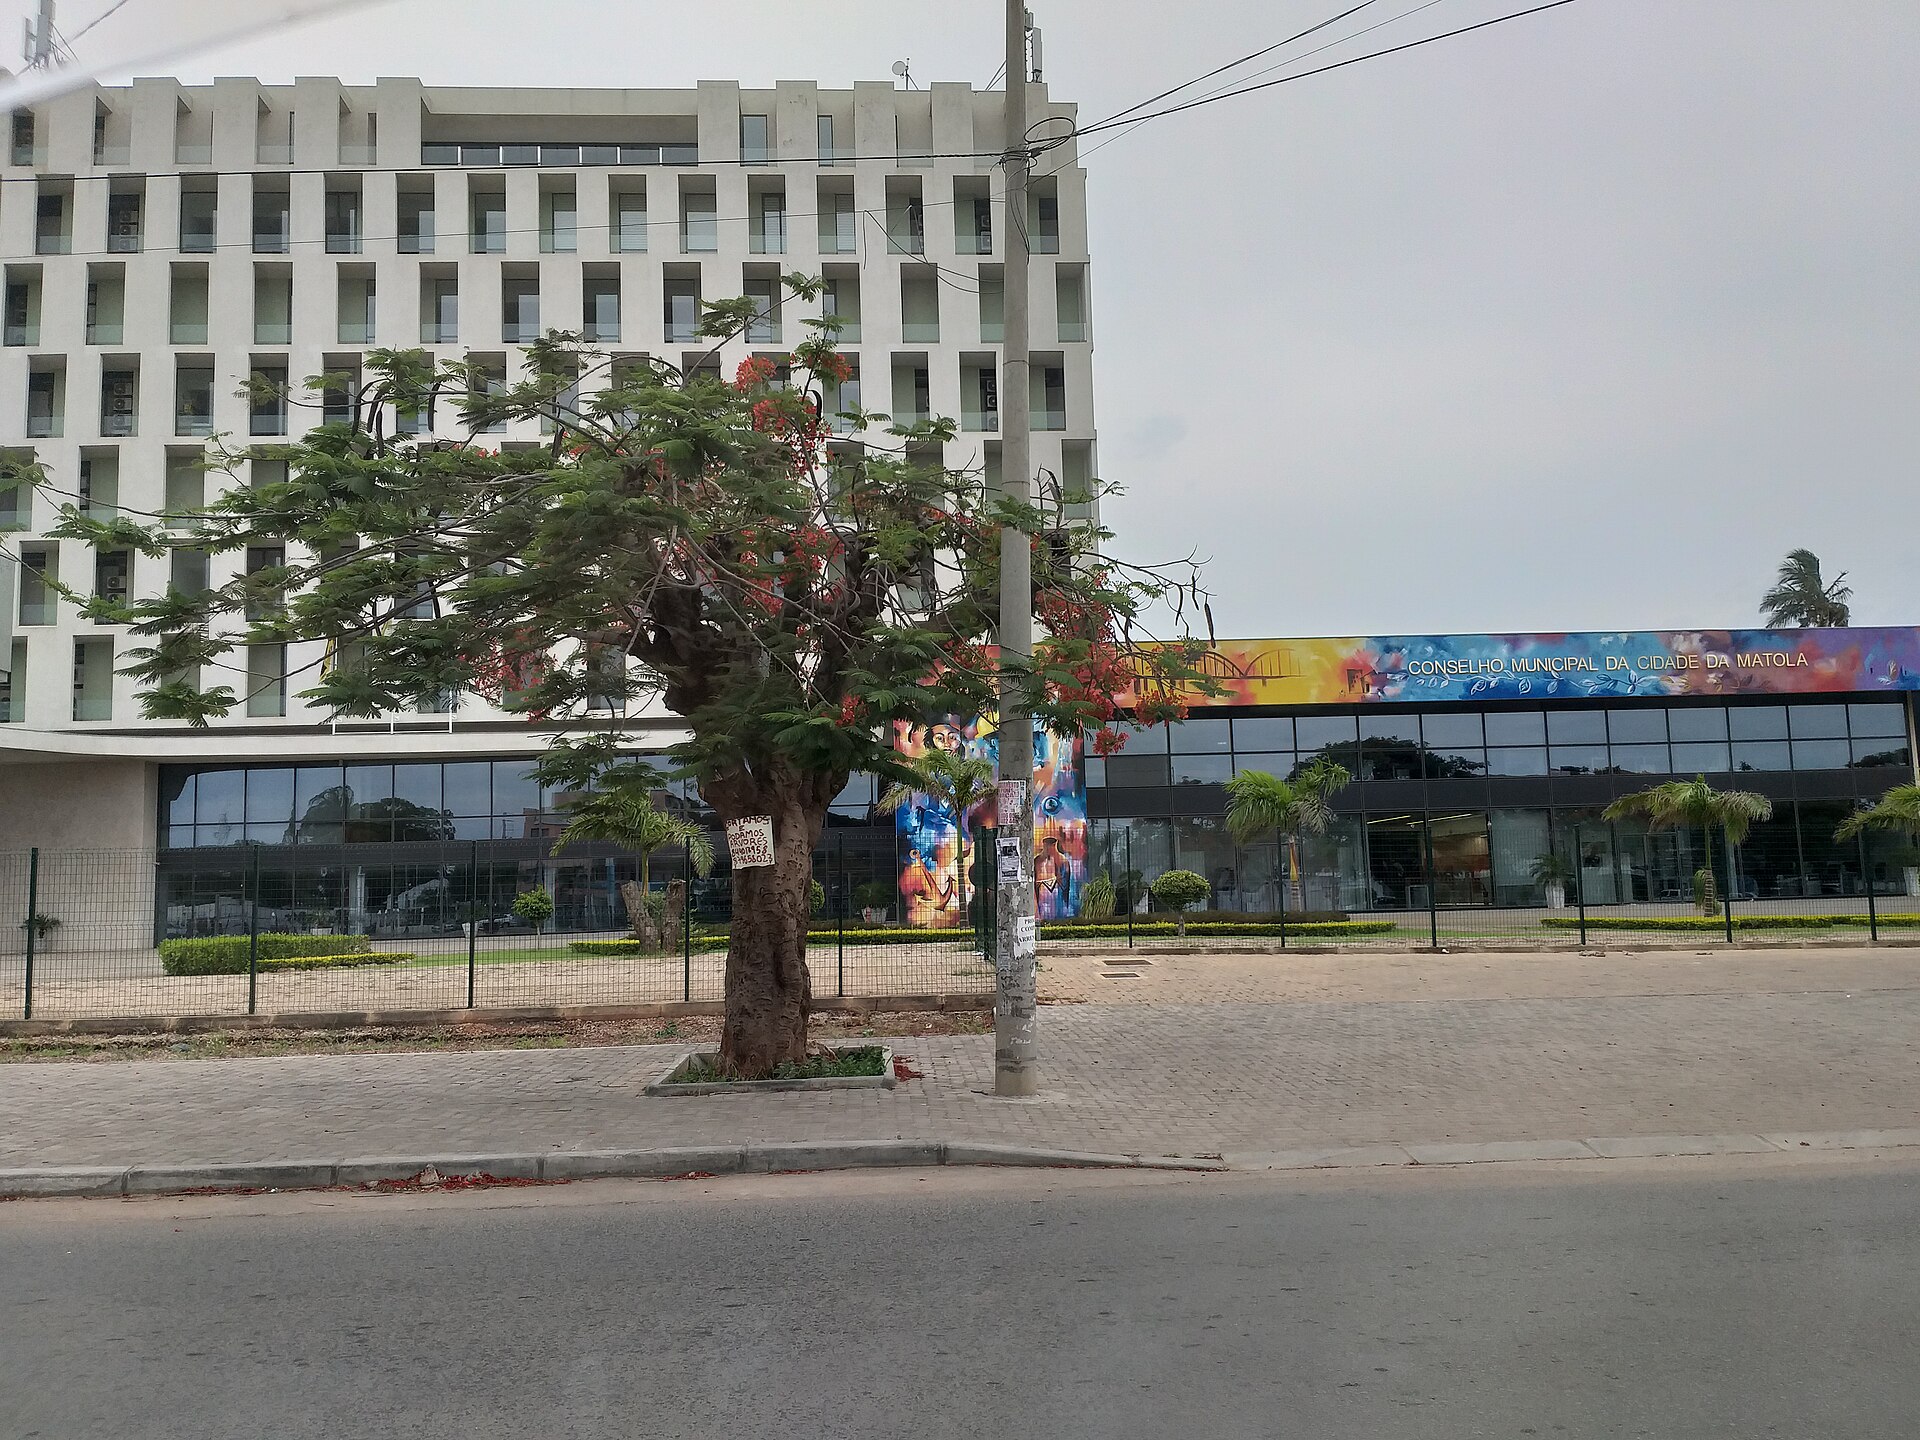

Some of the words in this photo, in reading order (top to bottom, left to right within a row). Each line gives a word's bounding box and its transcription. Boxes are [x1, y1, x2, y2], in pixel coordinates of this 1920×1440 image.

[1408, 659, 1504, 675] CONSELHO
[1511, 656, 1599, 673] MUNICIPAL
[1605, 656, 1629, 671] DA
[1637, 655, 1700, 670] CIDADE
[1706, 654, 1730, 669] DA
[1737, 652, 1809, 668] MATOLA
[728, 829, 764, 841] PODAMOS
